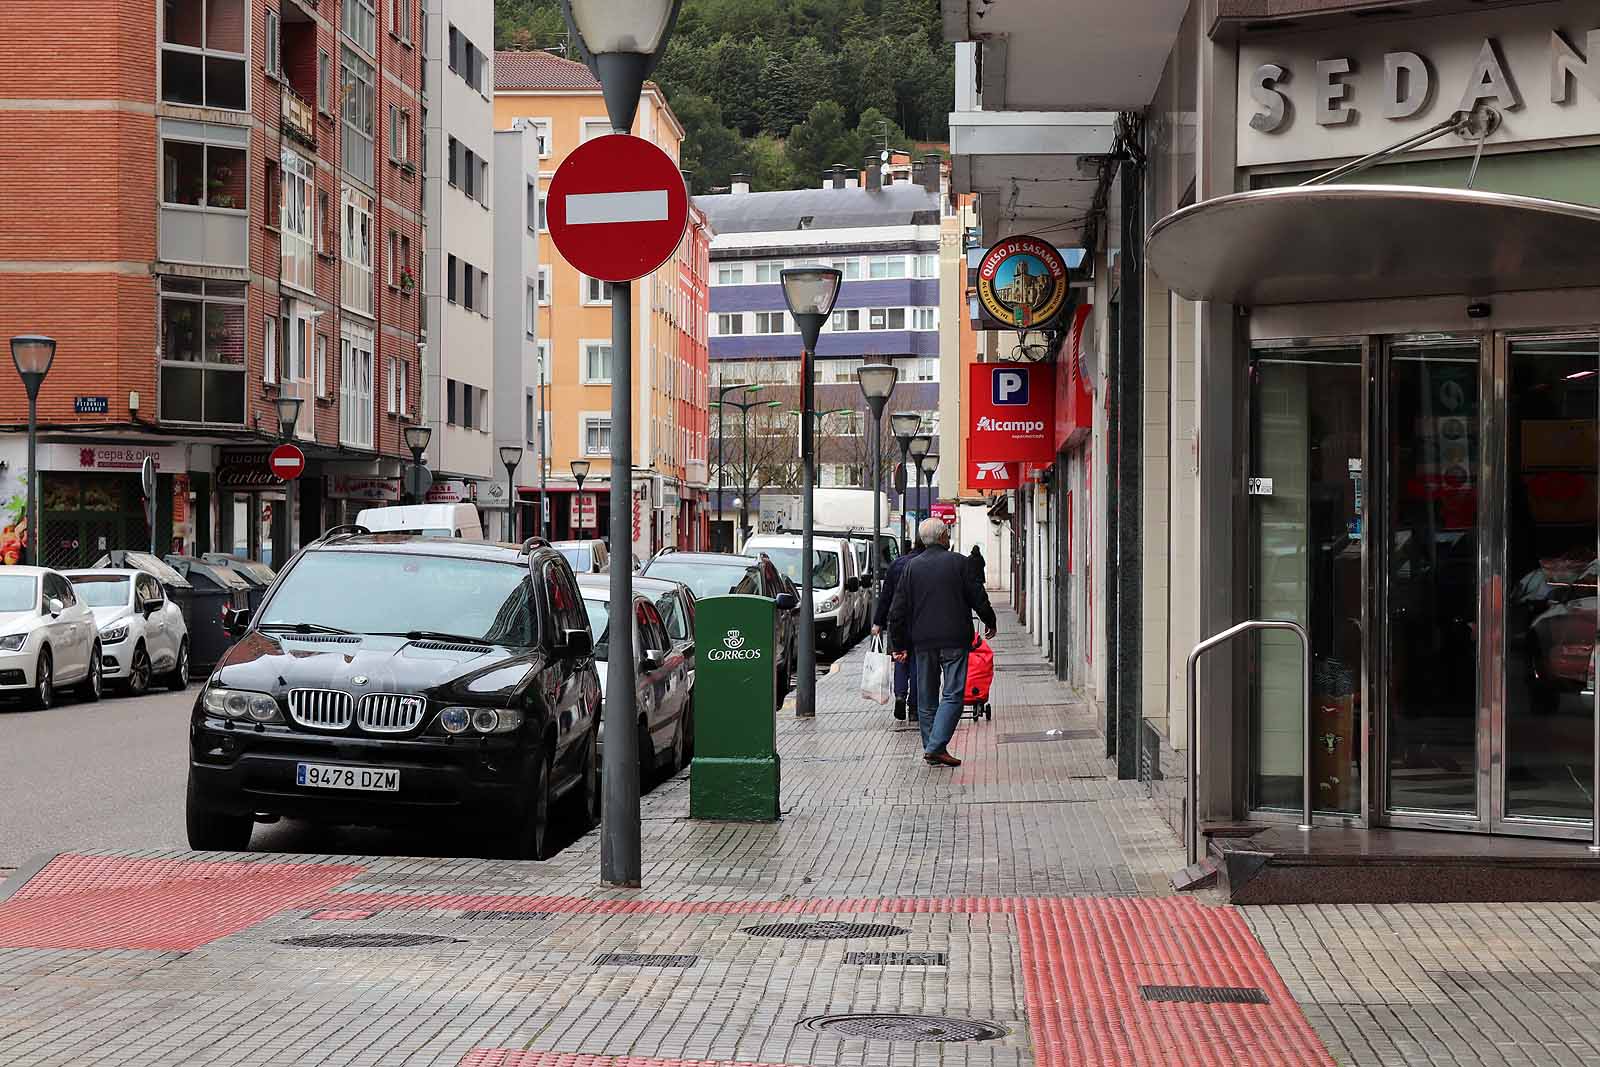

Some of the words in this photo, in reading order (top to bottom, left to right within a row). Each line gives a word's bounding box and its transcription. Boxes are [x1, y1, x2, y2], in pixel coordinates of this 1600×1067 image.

[983, 248, 1007, 277] QUESO
[1008, 244, 1020, 253] DE
[1022, 243, 1062, 276] SASAMON
[999, 373, 1021, 400] P
[976, 416, 1044, 433] Alcampo
[707, 648, 761, 661] CORREOS
[309, 767, 354, 787] 9478
[361, 771, 397, 789] DZM
